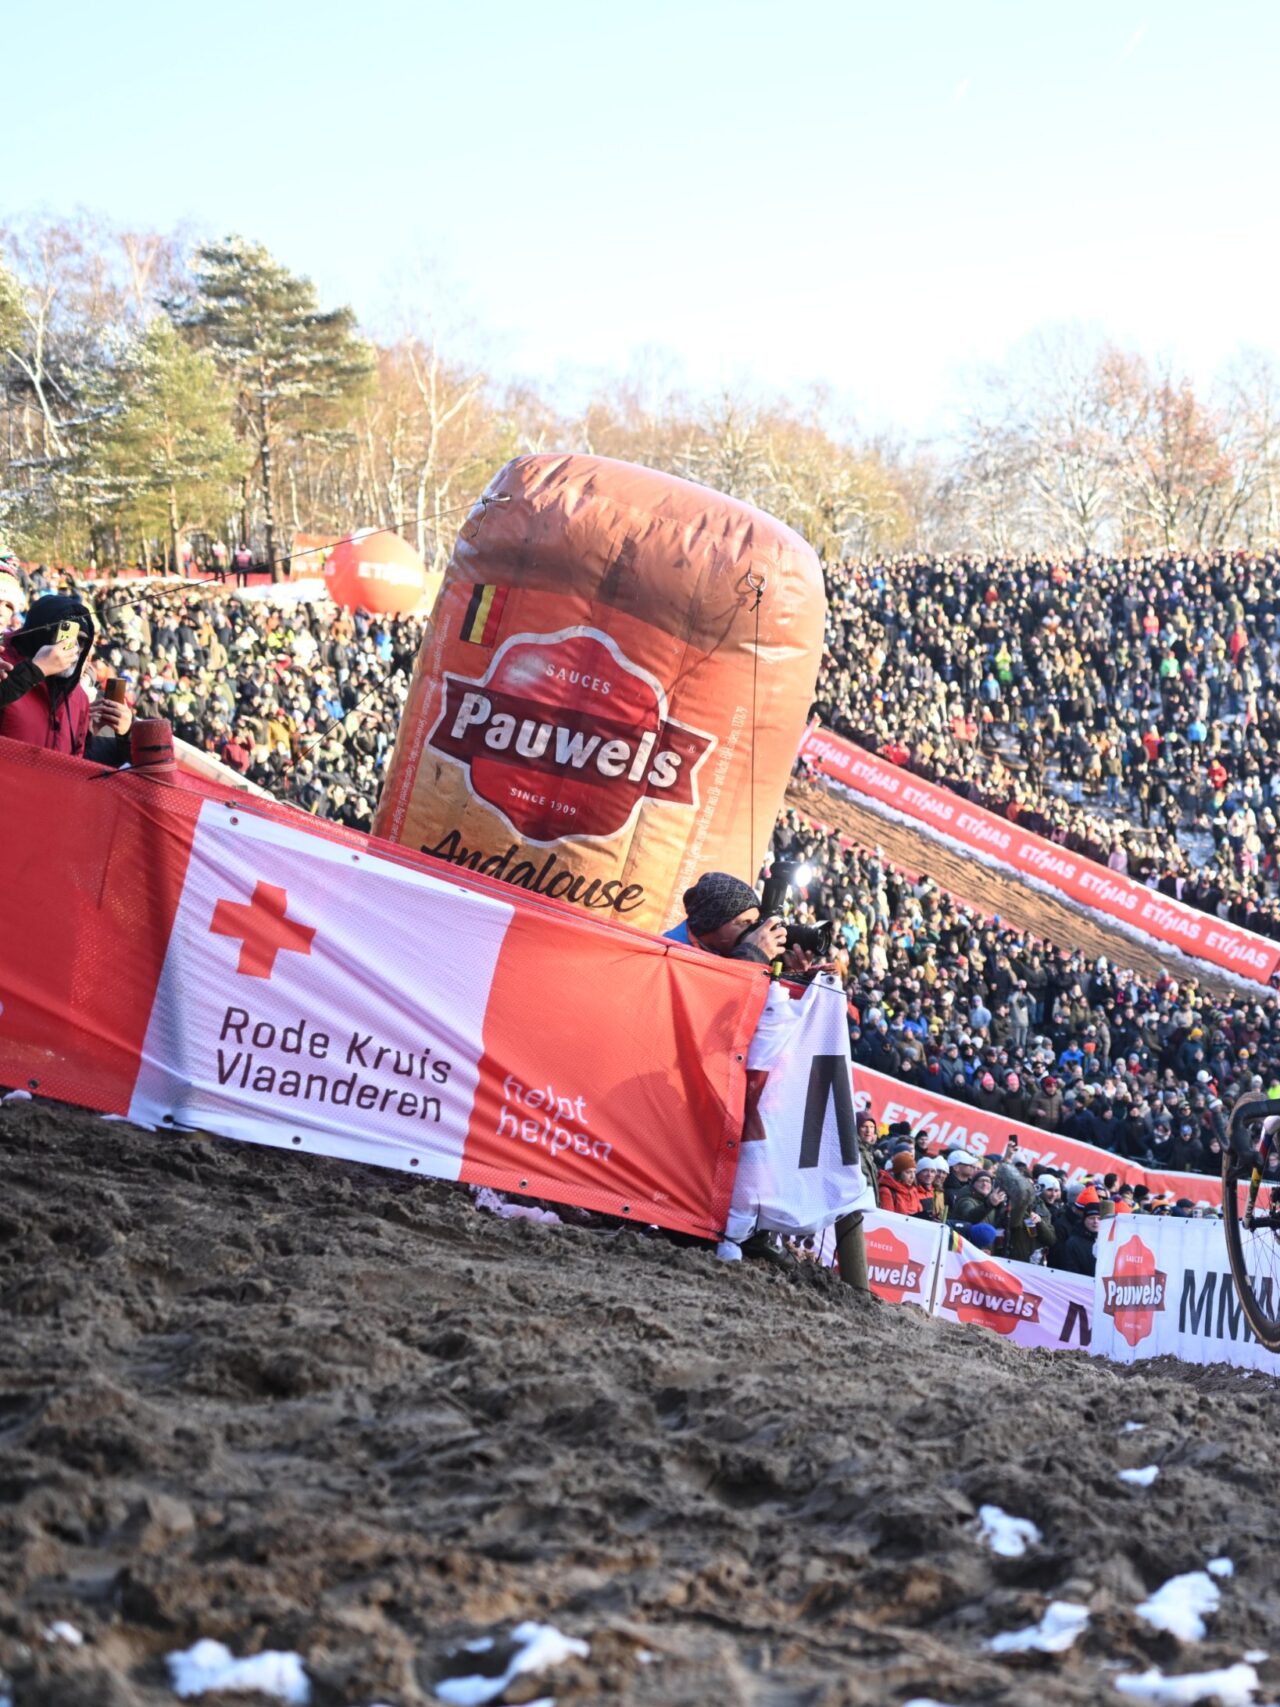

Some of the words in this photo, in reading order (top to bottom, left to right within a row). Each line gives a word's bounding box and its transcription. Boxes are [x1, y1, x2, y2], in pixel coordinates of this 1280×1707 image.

[545, 663, 612, 695] SAUCES
[450, 693, 682, 789] Pauwels
[509, 787, 545, 806] SINCE
[551, 800, 577, 816] 1909
[420, 829, 645, 913] Andalouse
[218, 1006, 331, 1059] Rode
[345, 1031, 453, 1084] Kruis
[216, 1049, 443, 1123] Vlaanderen
[502, 1074, 589, 1125] helpt
[496, 1106, 613, 1164] helpen
[950, 1282, 1034, 1318] Pauwels
[1107, 1279, 1163, 1306] Pauwels
